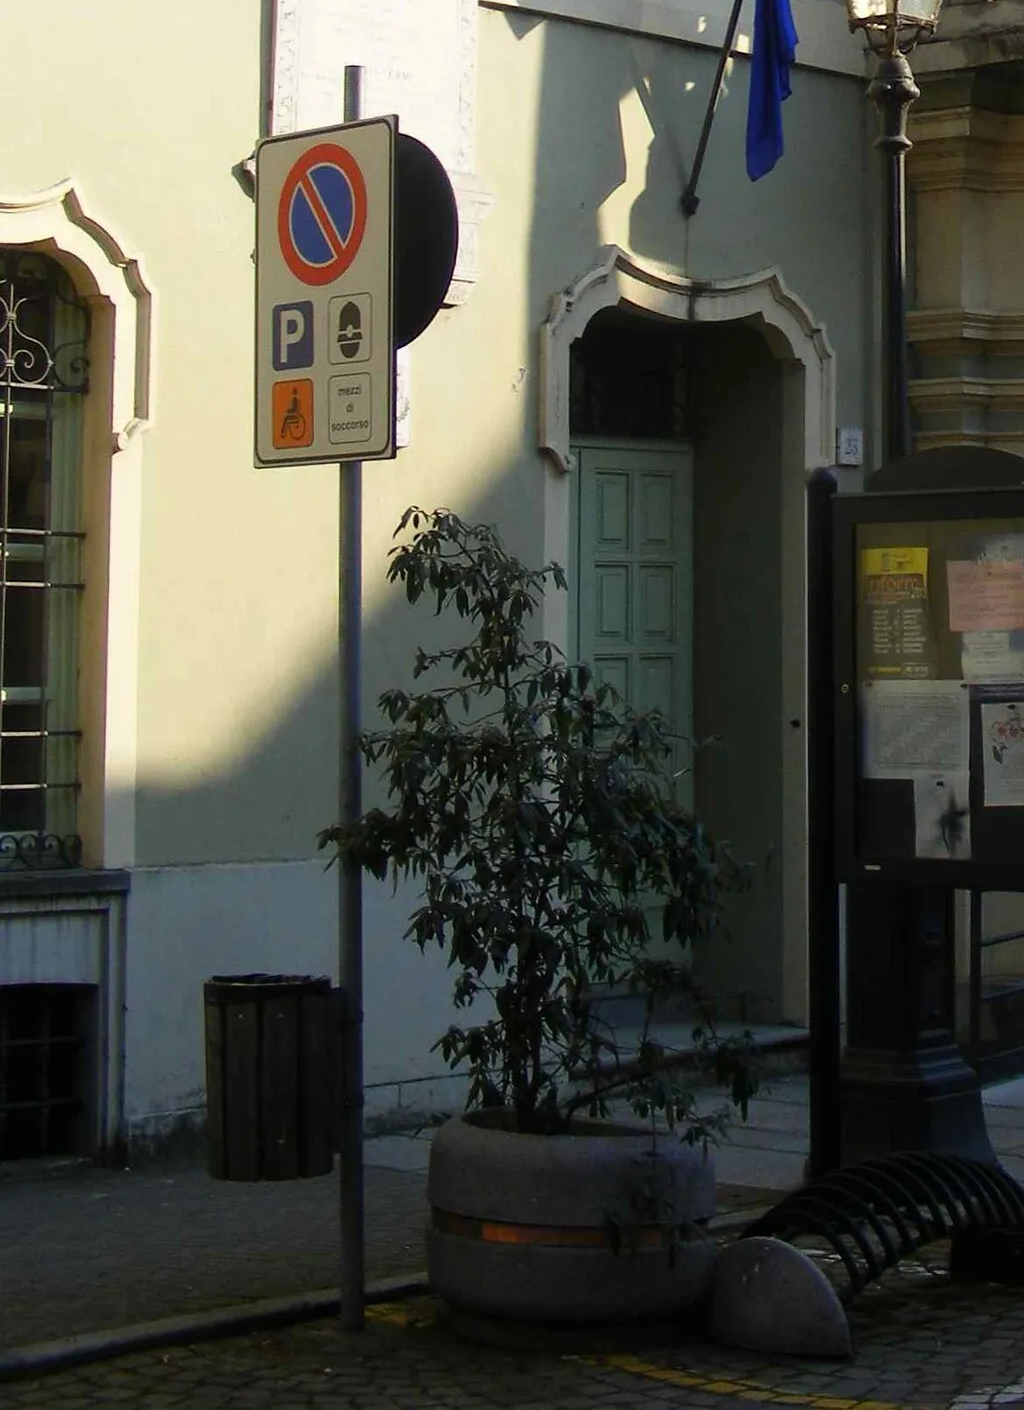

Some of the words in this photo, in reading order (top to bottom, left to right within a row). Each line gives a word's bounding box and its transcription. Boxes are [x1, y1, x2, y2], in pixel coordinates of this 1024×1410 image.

[280, 310, 305, 363] P
[338, 384, 362, 396] mezzi
[345, 402, 354, 413] di
[331, 420, 369, 432] soccorso
